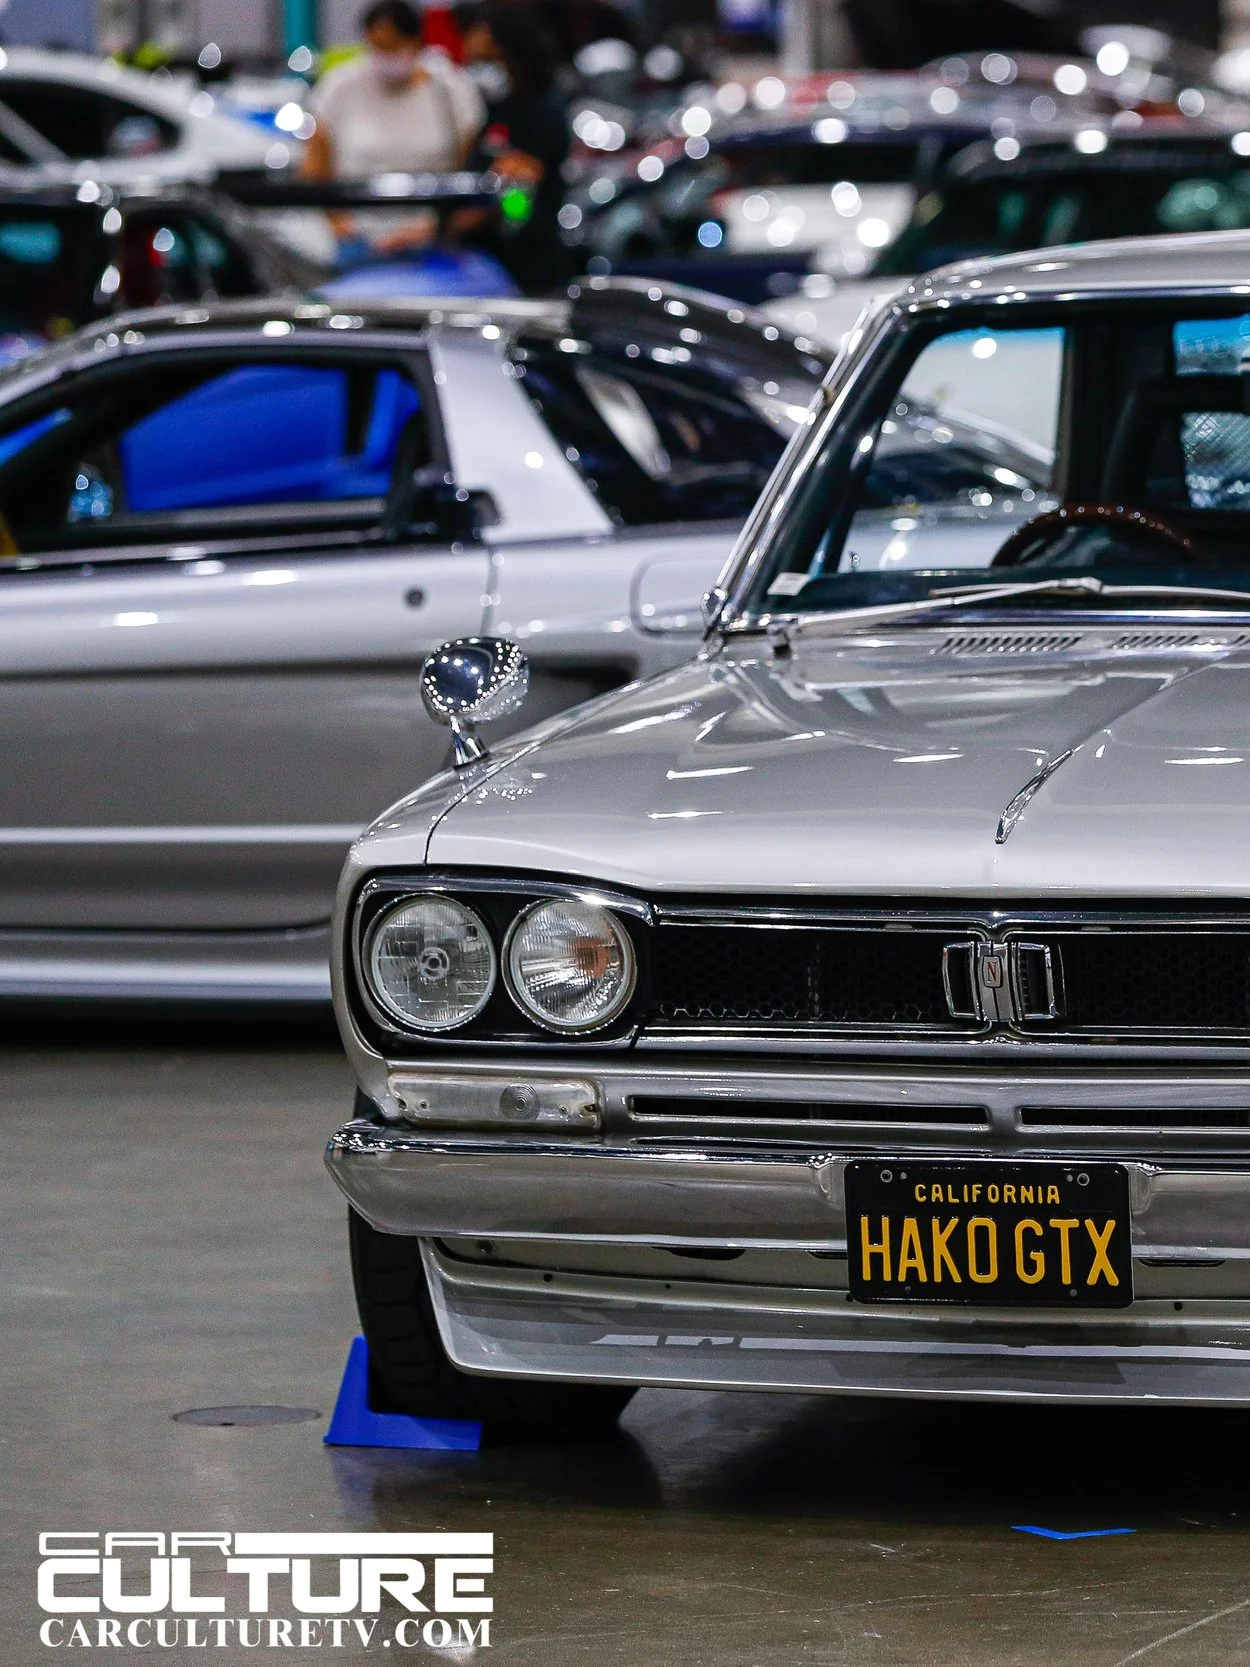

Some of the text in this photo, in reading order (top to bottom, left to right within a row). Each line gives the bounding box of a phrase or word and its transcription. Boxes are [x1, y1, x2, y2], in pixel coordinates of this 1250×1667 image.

[914, 1183, 1061, 1204] CALIFORNIA
[860, 1216, 1119, 1287] HAKO GTX
